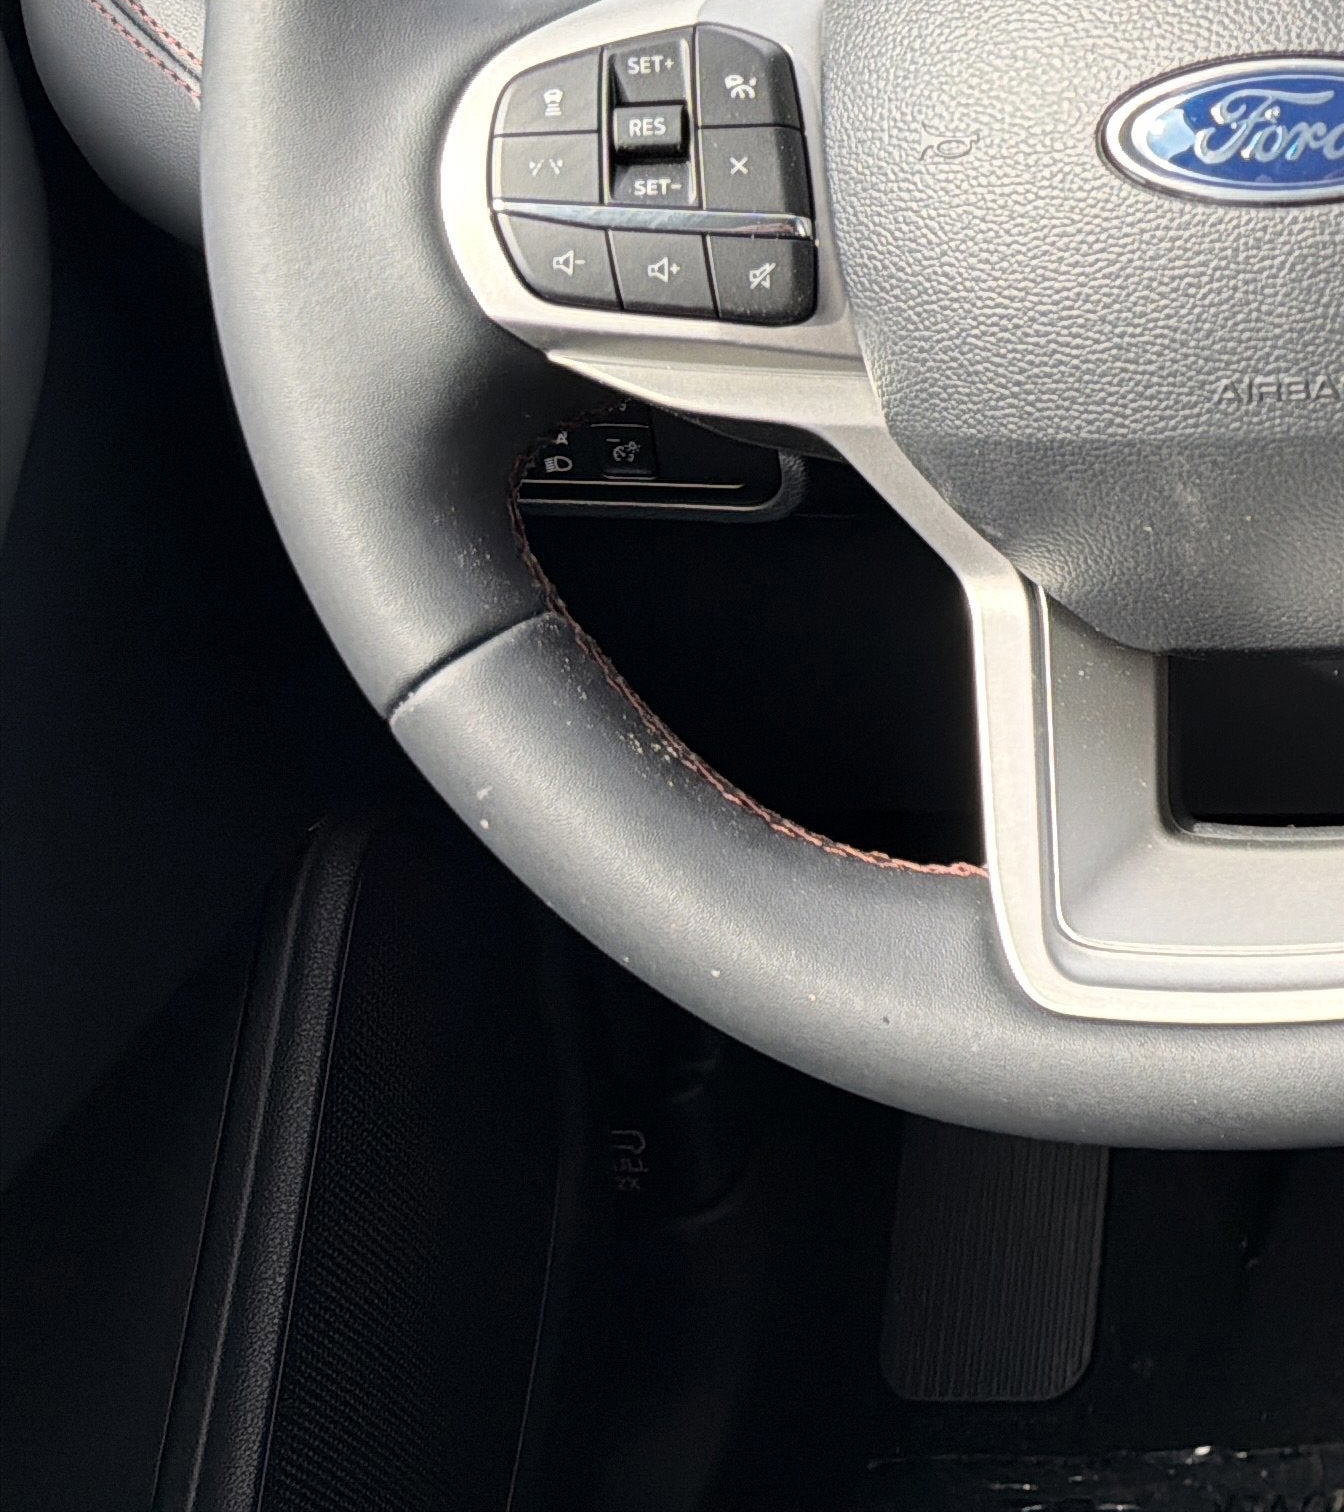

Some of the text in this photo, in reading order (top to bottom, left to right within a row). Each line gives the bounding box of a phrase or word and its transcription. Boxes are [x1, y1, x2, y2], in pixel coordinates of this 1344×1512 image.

[627, 55, 675, 75] SET+
[629, 118, 666, 137] RES
[634, 178, 682, 196] SET-
